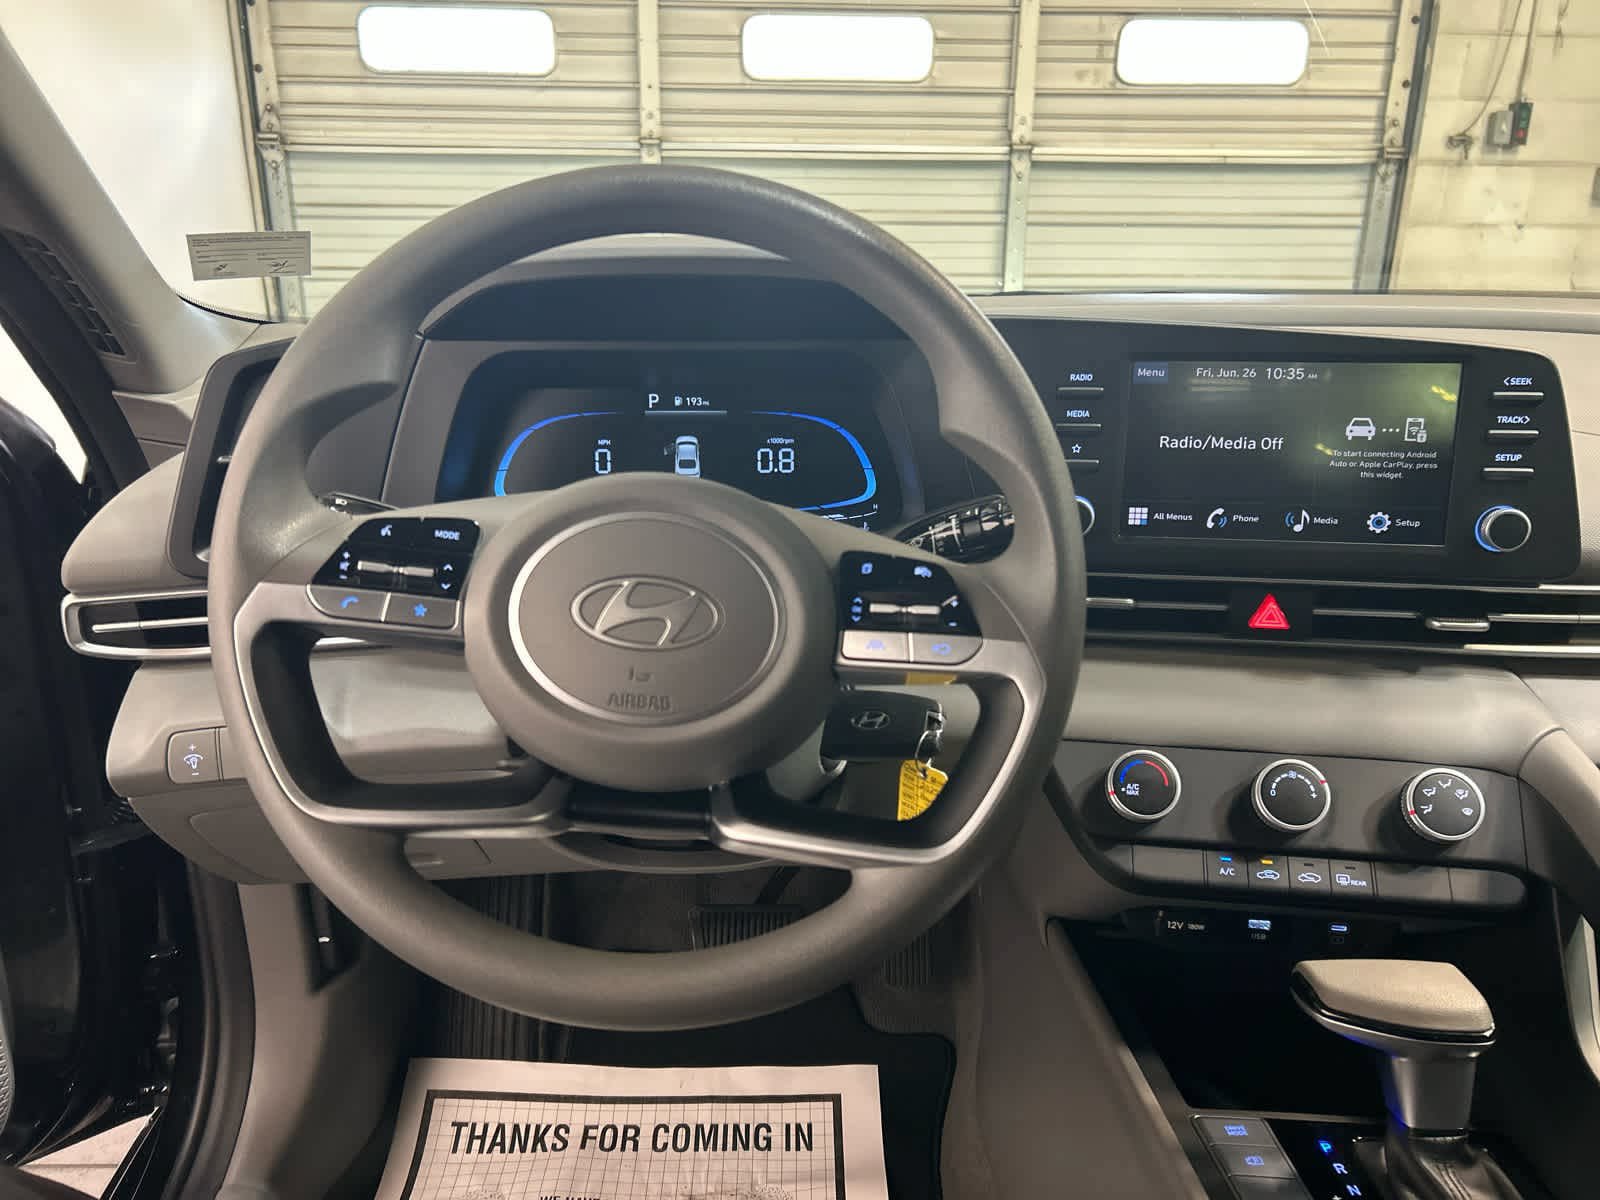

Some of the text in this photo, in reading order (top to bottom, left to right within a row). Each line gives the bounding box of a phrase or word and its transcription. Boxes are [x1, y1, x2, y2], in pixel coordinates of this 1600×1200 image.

[1070, 373, 1093, 381] RADIO
[1137, 368, 1165, 377] Menu
[1196, 368, 1214, 378] Fri,
[1216, 368, 1238, 378] Jun.
[1242, 368, 1257, 378] 26
[1266, 367, 1305, 380] 10:35
[648, 393, 660, 408] P
[685, 397, 702, 407] 193
[1066, 409, 1090, 418] MEDIA
[1159, 434, 1285, 450] Radio/Media Off
[1343, 450, 1362, 458] start
[1363, 451, 1405, 460] connecting
[1406, 451, 1437, 459] Android
[1494, 453, 1523, 462] SETUP
[595, 448, 612, 474] 0
[757, 448, 795, 474] 0.8
[1359, 461, 1382, 469] Apple
[1360, 471, 1403, 480] this widget.
[1153, 512, 1193, 521] All Menus
[1232, 514, 1259, 523] Phone
[1313, 517, 1339, 525] Media
[1395, 519, 1421, 528] Setup
[434, 529, 461, 541] MODE
[1219, 867, 1235, 876] A/C
[1350, 879, 1368, 887] REAR
[1167, 920, 1184, 930] 12V
[450, 1121, 814, 1155] THANKS FOR COMING IN
[1319, 1140, 1333, 1154] P
[1332, 1162, 1348, 1175] R
[1346, 1184, 1362, 1197] N
